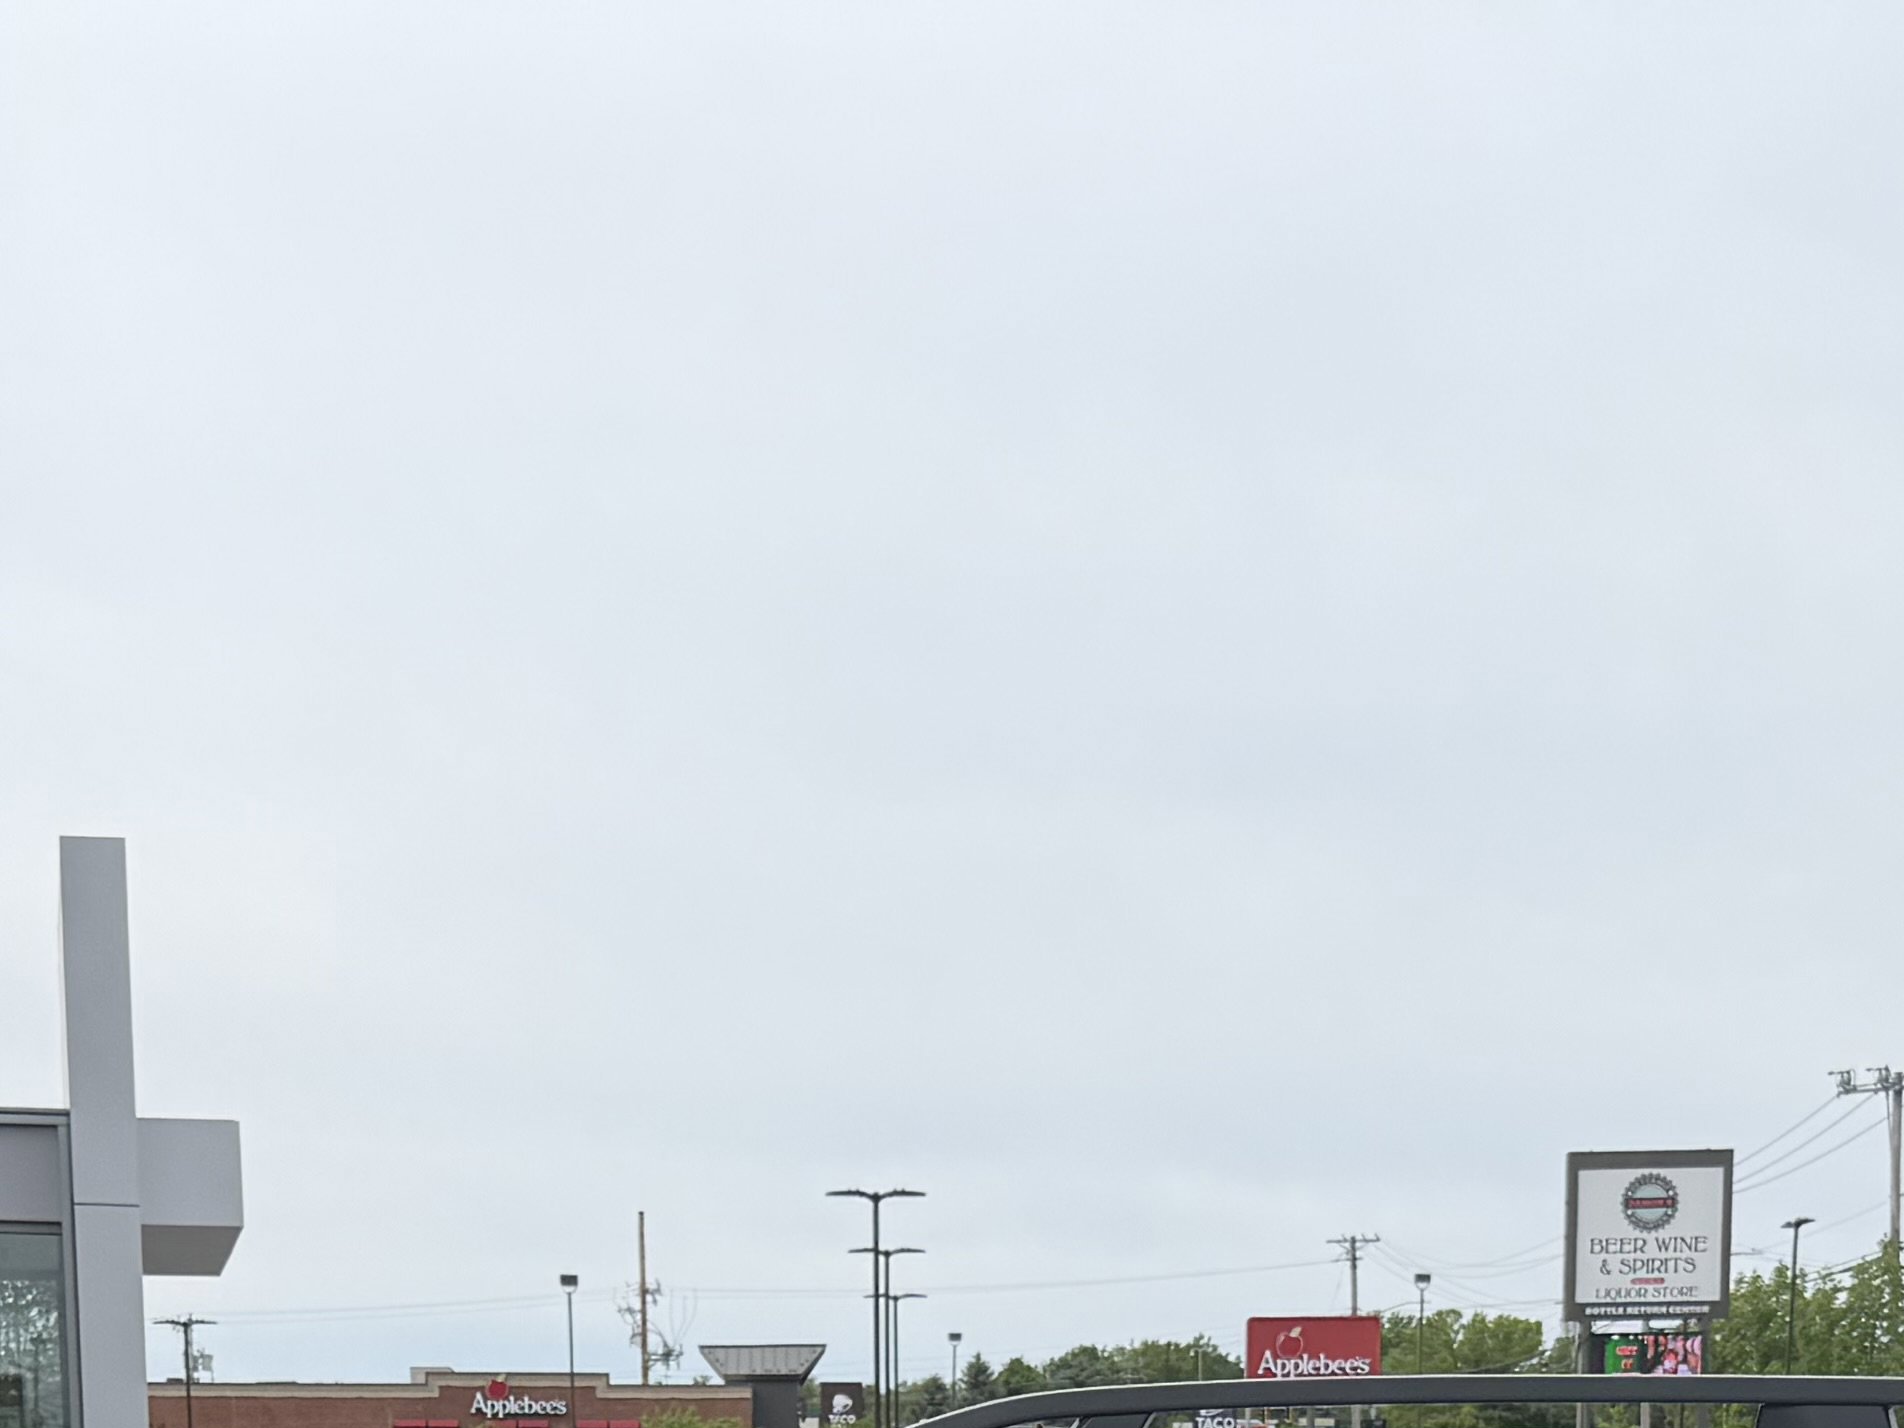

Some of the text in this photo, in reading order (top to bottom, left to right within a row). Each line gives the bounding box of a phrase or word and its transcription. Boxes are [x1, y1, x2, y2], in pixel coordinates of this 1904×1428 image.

[1589, 1235, 1708, 1255] BEER WINE
[1599, 1256, 1697, 1275] & SPIRITS
[1595, 1285, 1699, 1301] LIQUOR STORE
[1257, 1350, 1371, 1378] Applebee's
[470, 1393, 567, 1418] Applebee's
